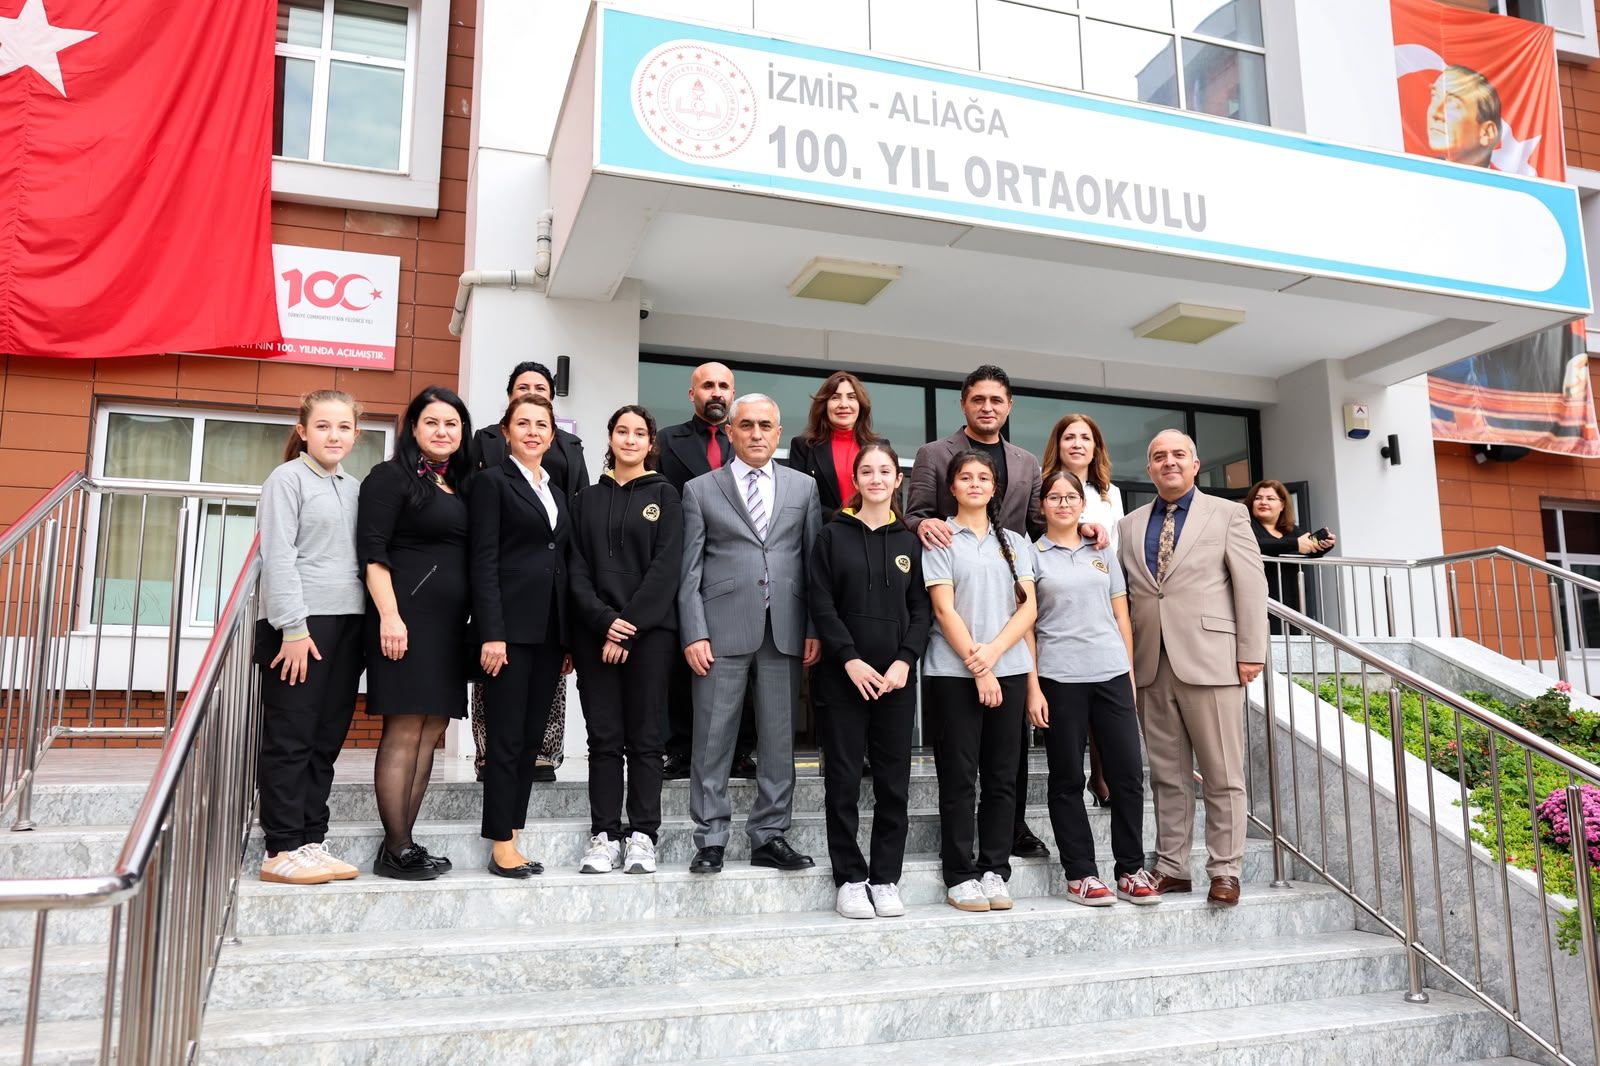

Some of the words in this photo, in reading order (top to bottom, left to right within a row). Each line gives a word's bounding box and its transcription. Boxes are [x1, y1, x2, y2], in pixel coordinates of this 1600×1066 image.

[768, 62, 860, 114] İZMİR
[887, 91, 1009, 138] ALİAĞA
[768, 125, 862, 180] 100.
[877, 141, 949, 193] YIL
[964, 155, 1207, 232] ORTAOKULU
[276, 343, 296, 353] 100.
[299, 345, 334, 356] YILINDA
[336, 348, 386, 360] AÇILMIŞTIR.
